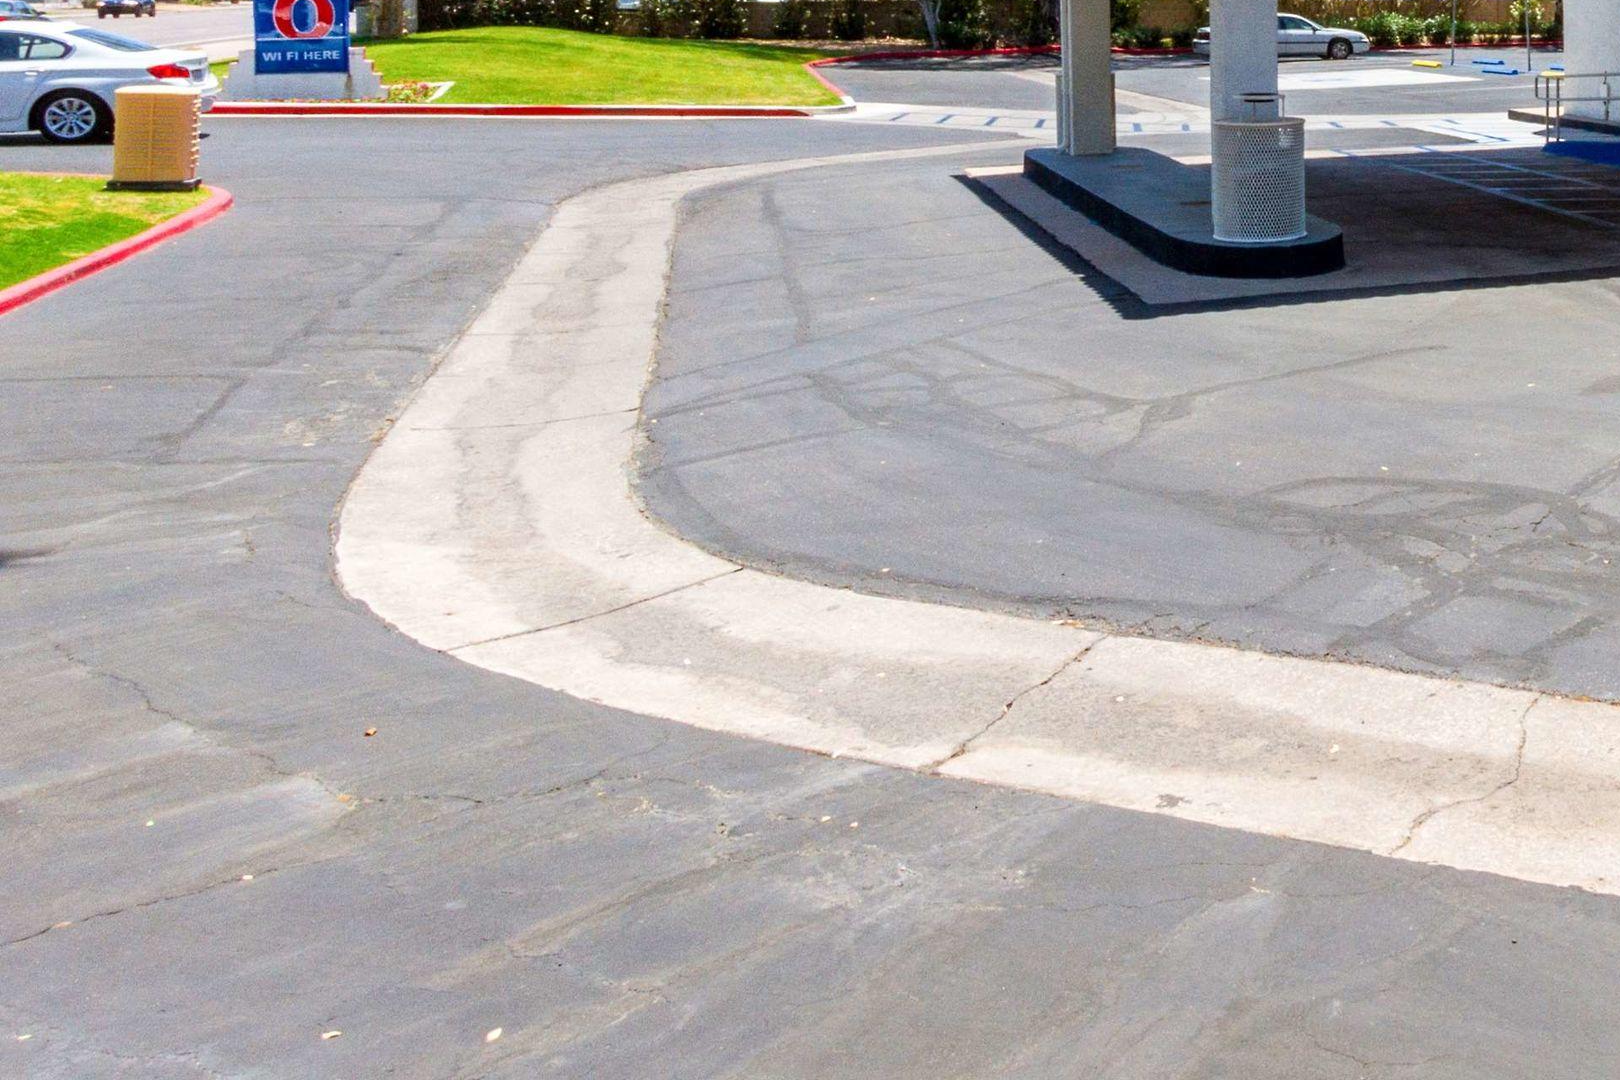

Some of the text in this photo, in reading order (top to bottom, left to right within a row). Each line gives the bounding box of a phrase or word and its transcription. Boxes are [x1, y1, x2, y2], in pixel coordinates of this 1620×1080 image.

[262, 50, 341, 61] WI FI HERE
